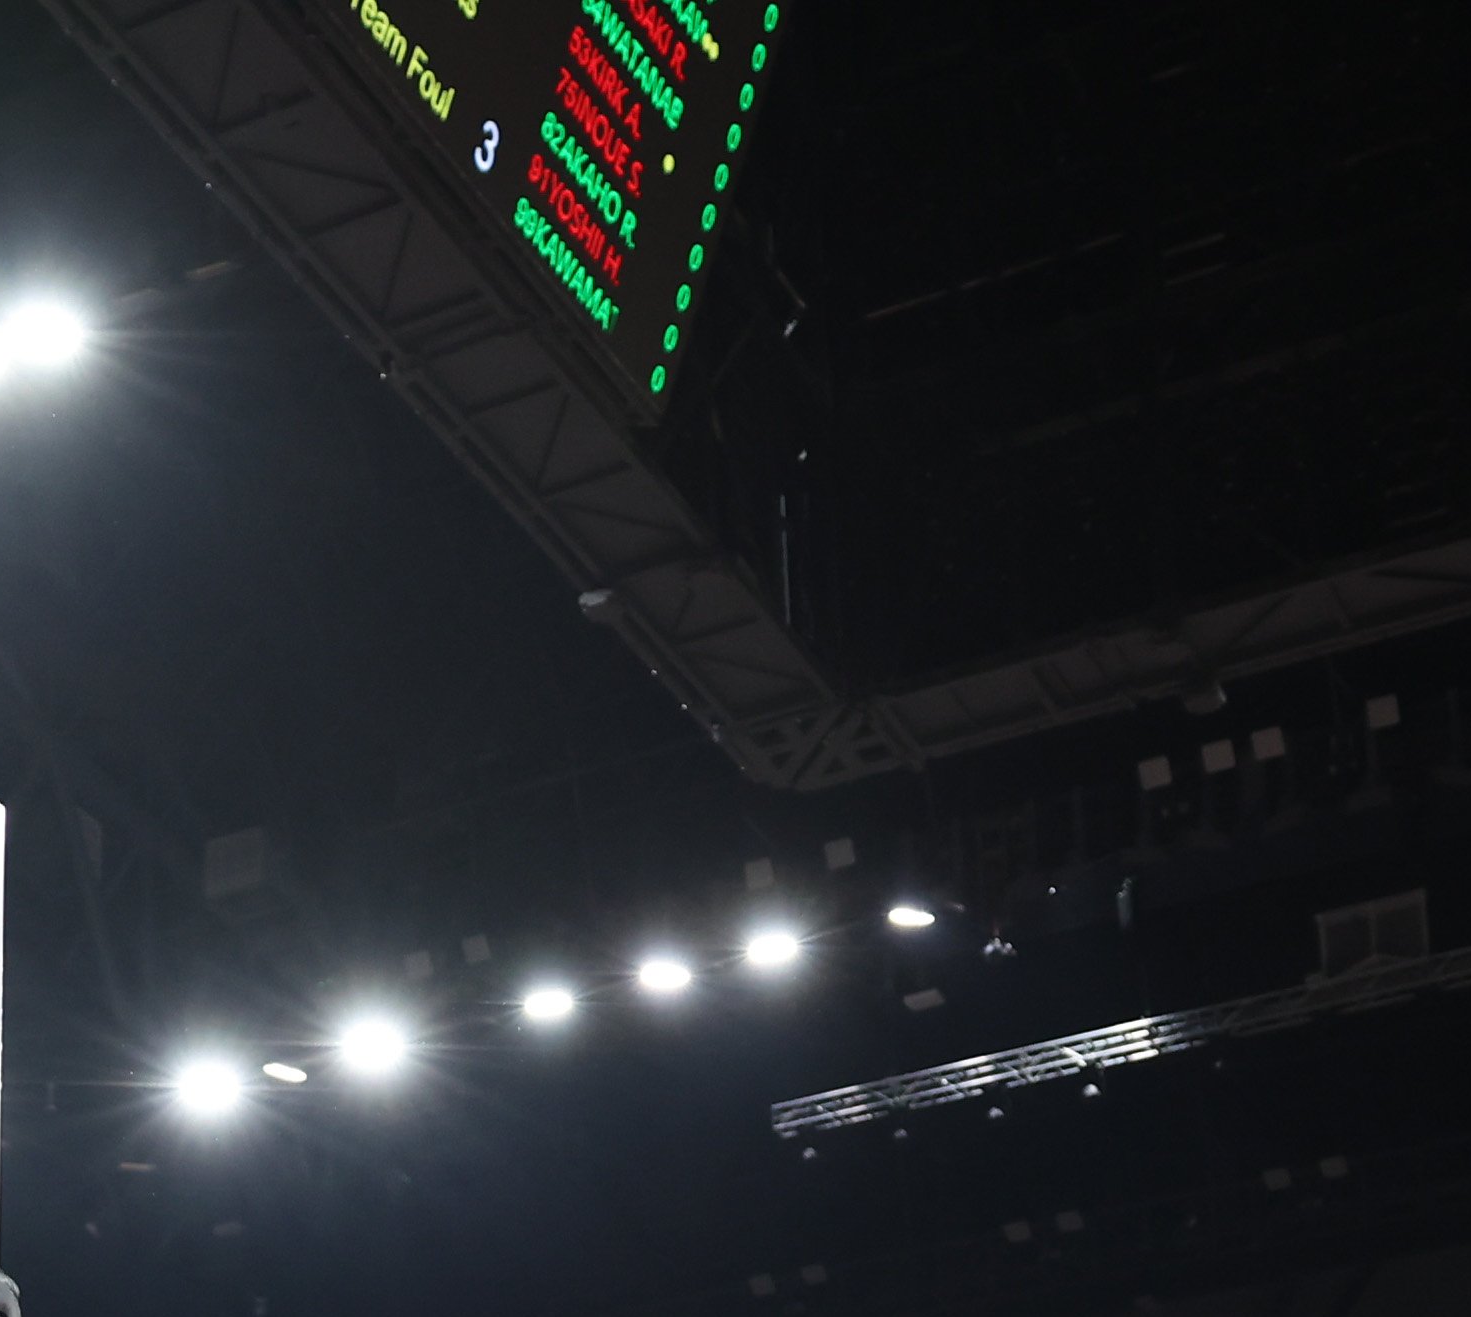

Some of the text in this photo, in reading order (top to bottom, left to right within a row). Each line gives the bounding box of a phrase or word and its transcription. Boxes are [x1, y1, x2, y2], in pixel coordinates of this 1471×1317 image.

[351, 0, 500, 173] eam Foul 3
